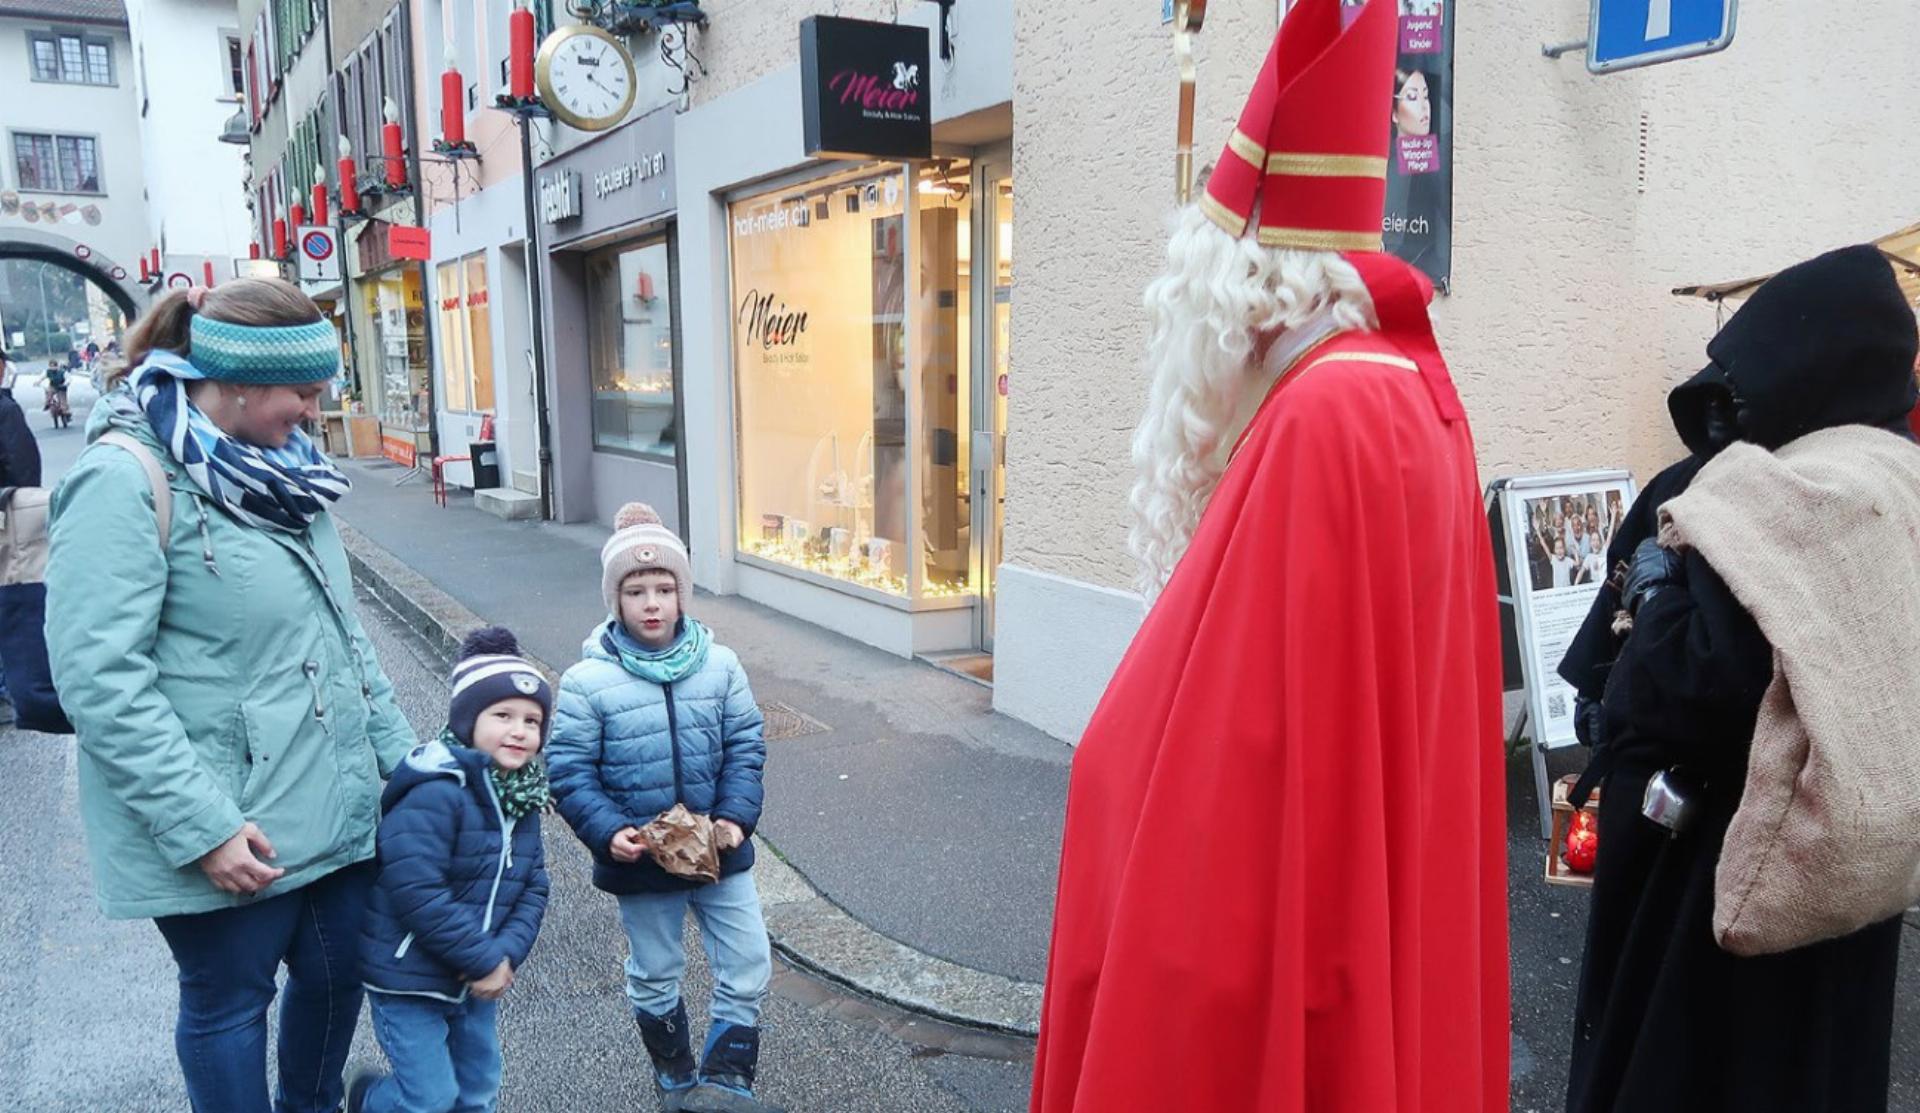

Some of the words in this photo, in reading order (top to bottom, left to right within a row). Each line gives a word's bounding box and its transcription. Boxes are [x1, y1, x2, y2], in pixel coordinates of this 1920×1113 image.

[1406, 20, 1432, 32] Jugend
[1408, 39, 1432, 48] Kinder
[828, 70, 918, 110] Meier
[863, 109, 883, 119] Beauty
[884, 110, 890, 119] &
[1408, 161, 1428, 172] Pflege
[735, 200, 809, 236] hair-meier.ch
[1382, 212, 1429, 234] eier.ch
[738, 288, 807, 350] Meier
